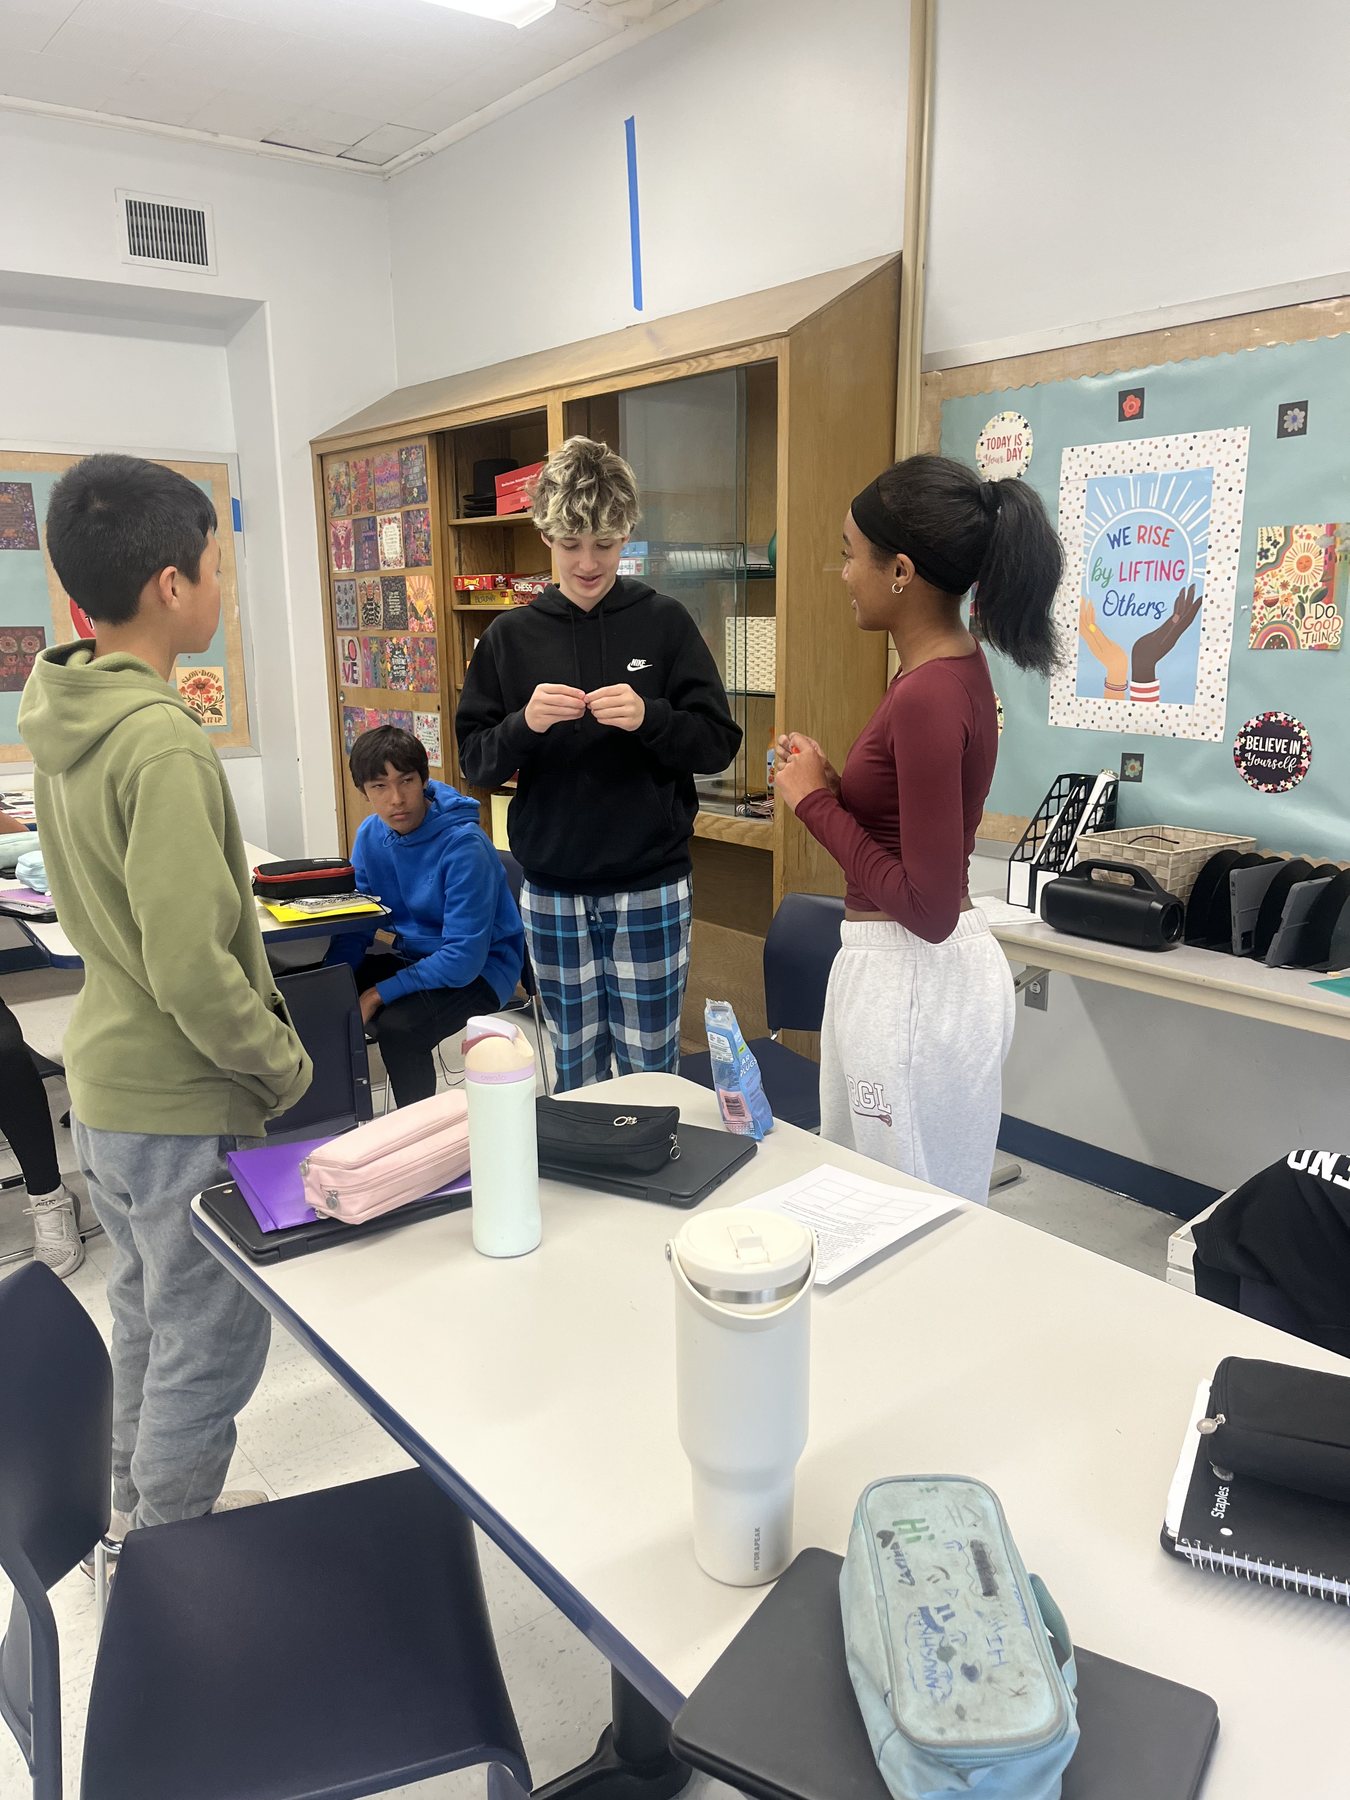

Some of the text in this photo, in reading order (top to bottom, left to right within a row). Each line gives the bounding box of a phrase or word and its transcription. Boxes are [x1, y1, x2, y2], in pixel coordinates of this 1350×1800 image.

[986, 432, 1023, 451] TODAY IS
[1006, 447, 1023, 462] DAY
[1106, 524, 1175, 550] WE RISE
[1091, 556, 1185, 589] by LIFTING
[514, 582, 533, 592] CHESS
[1102, 589, 1168, 620] Others
[1315, 603, 1336, 620] DO
[1303, 615, 1342, 632] GOOD
[1302, 630, 1340, 645] THINGS
[631, 658, 647, 667] NIKE
[1245, 735, 1301, 756] BELIEVE IN
[1245, 752, 1297, 773] Yourself
[1210, 1485, 1231, 1519] Staples
[753, 1526, 761, 1571] HYDRAPEAK
